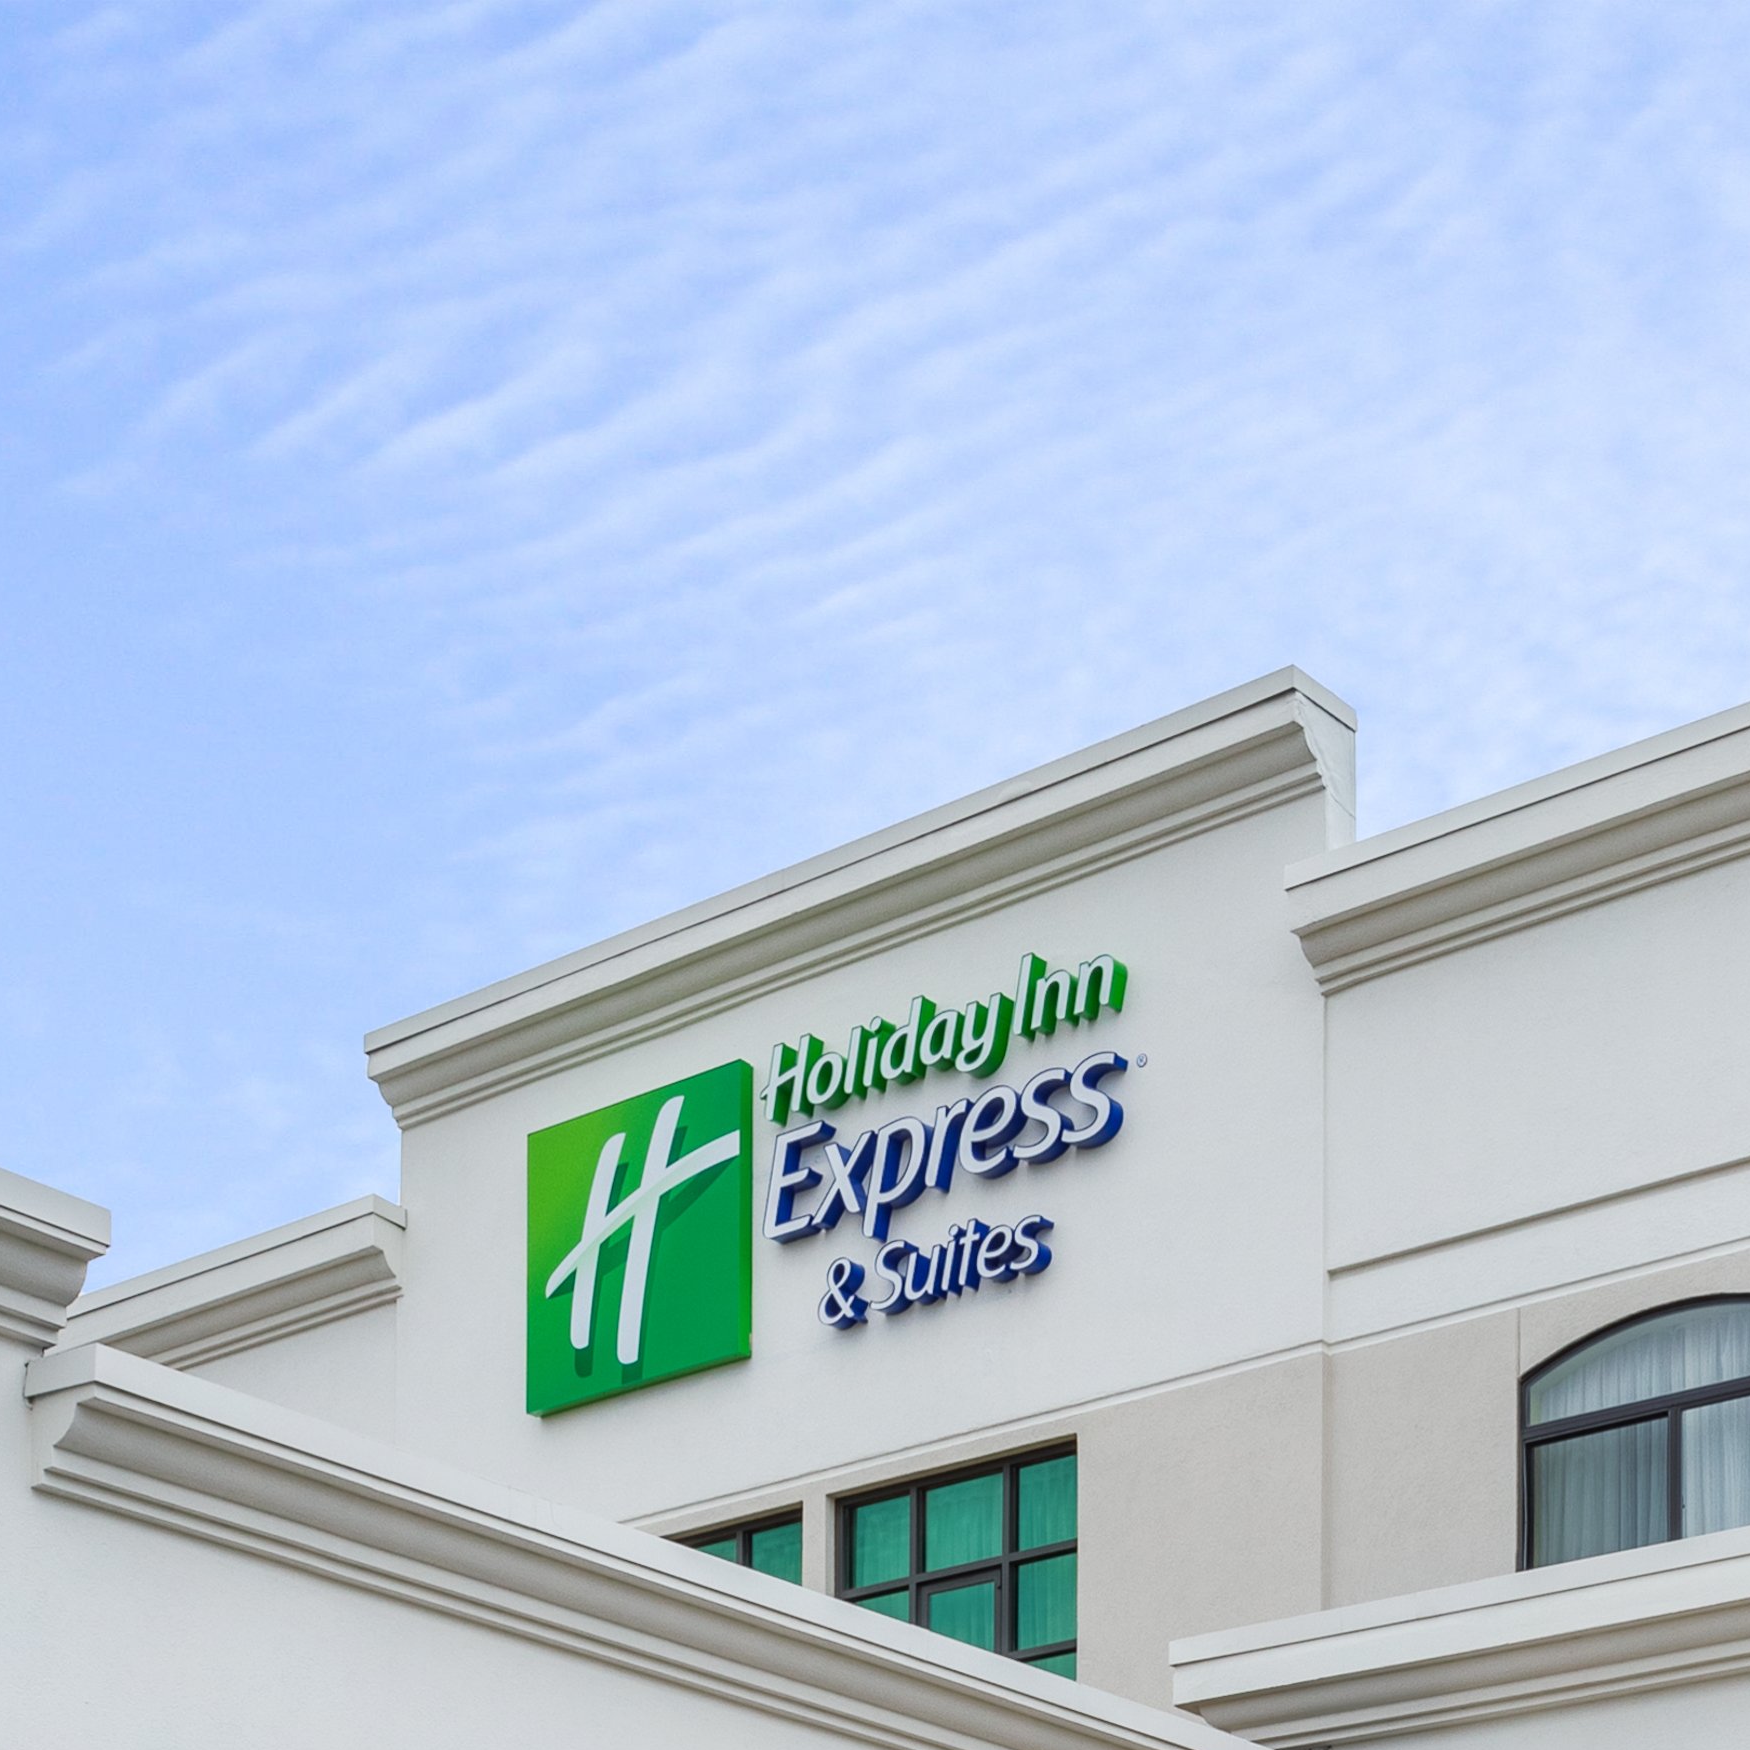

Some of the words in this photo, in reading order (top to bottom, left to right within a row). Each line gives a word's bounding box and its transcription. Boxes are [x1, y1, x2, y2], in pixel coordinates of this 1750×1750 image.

[761, 992, 1015, 1125] Holiday
[1013, 952, 1128, 1039] Inn
[762, 1050, 1128, 1244] Express
[818, 1257, 868, 1330] &
[870, 1214, 1054, 1316] Suites
